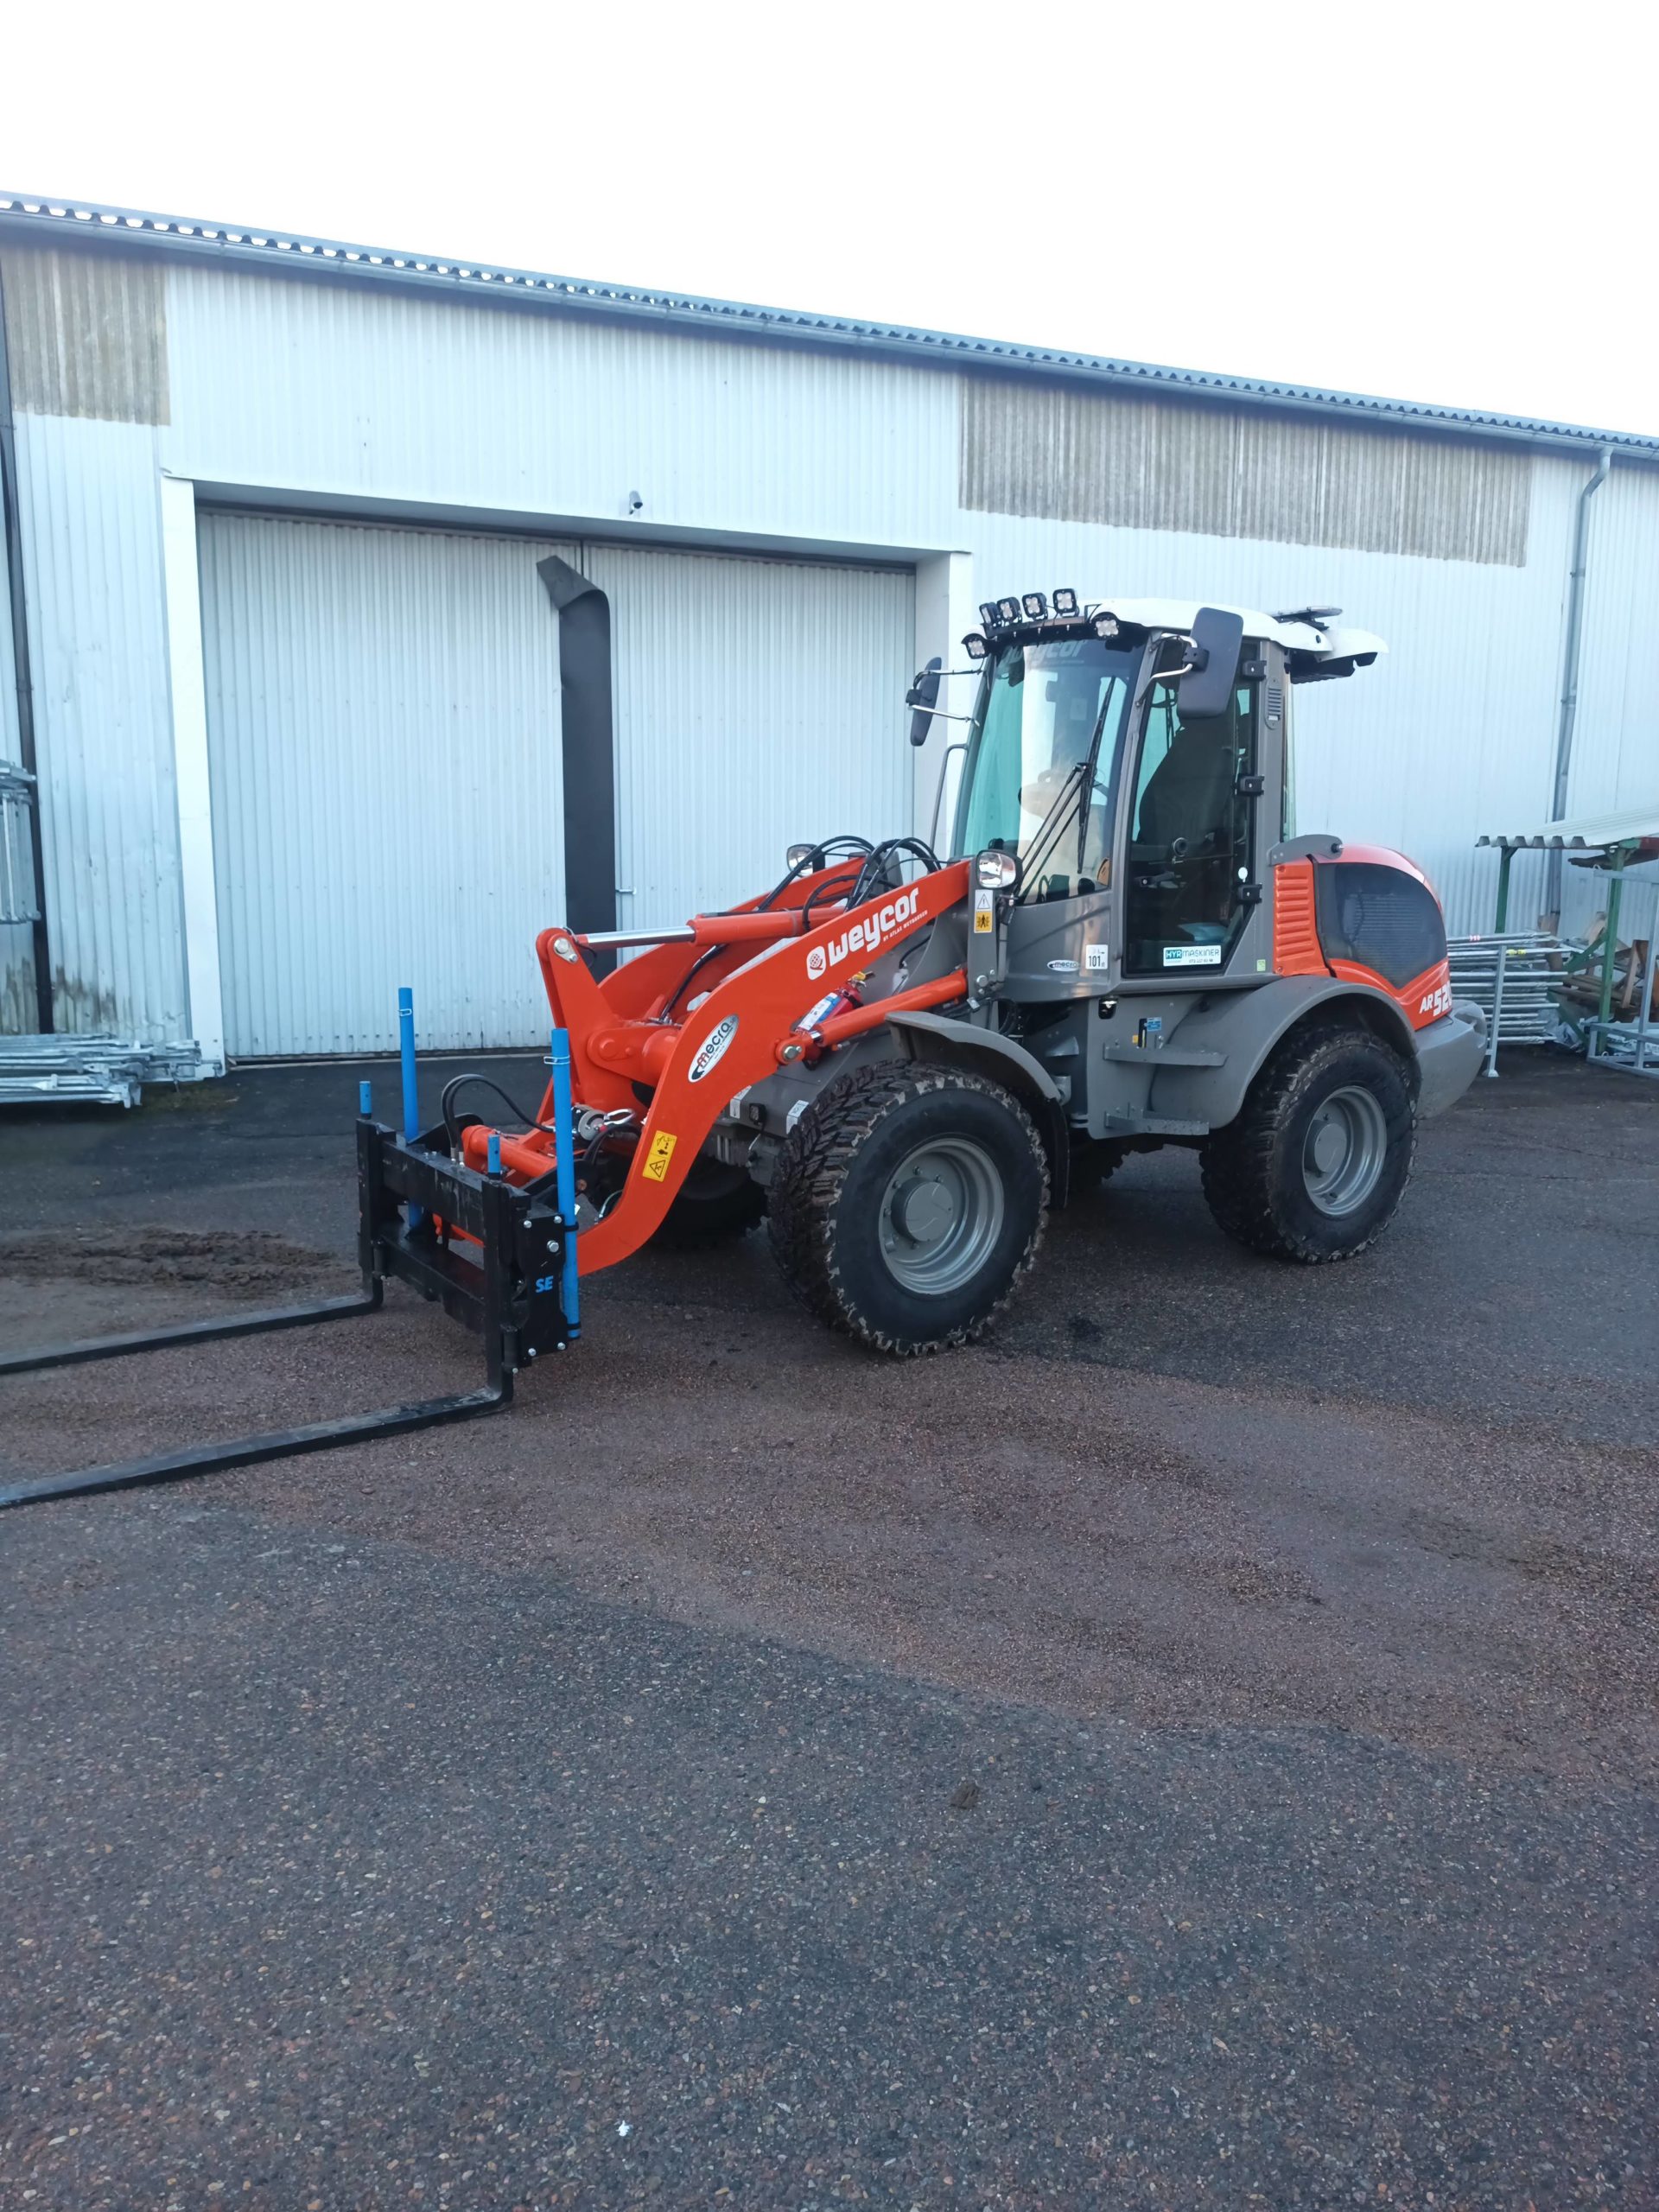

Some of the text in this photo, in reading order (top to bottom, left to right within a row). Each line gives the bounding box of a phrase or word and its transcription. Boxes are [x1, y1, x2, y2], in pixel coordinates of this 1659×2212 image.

[828, 887, 918, 967] weycor
[1089, 956, 1101, 967] 101
[696, 1022, 731, 1068] mecra
[536, 1275, 553, 1293] SE
